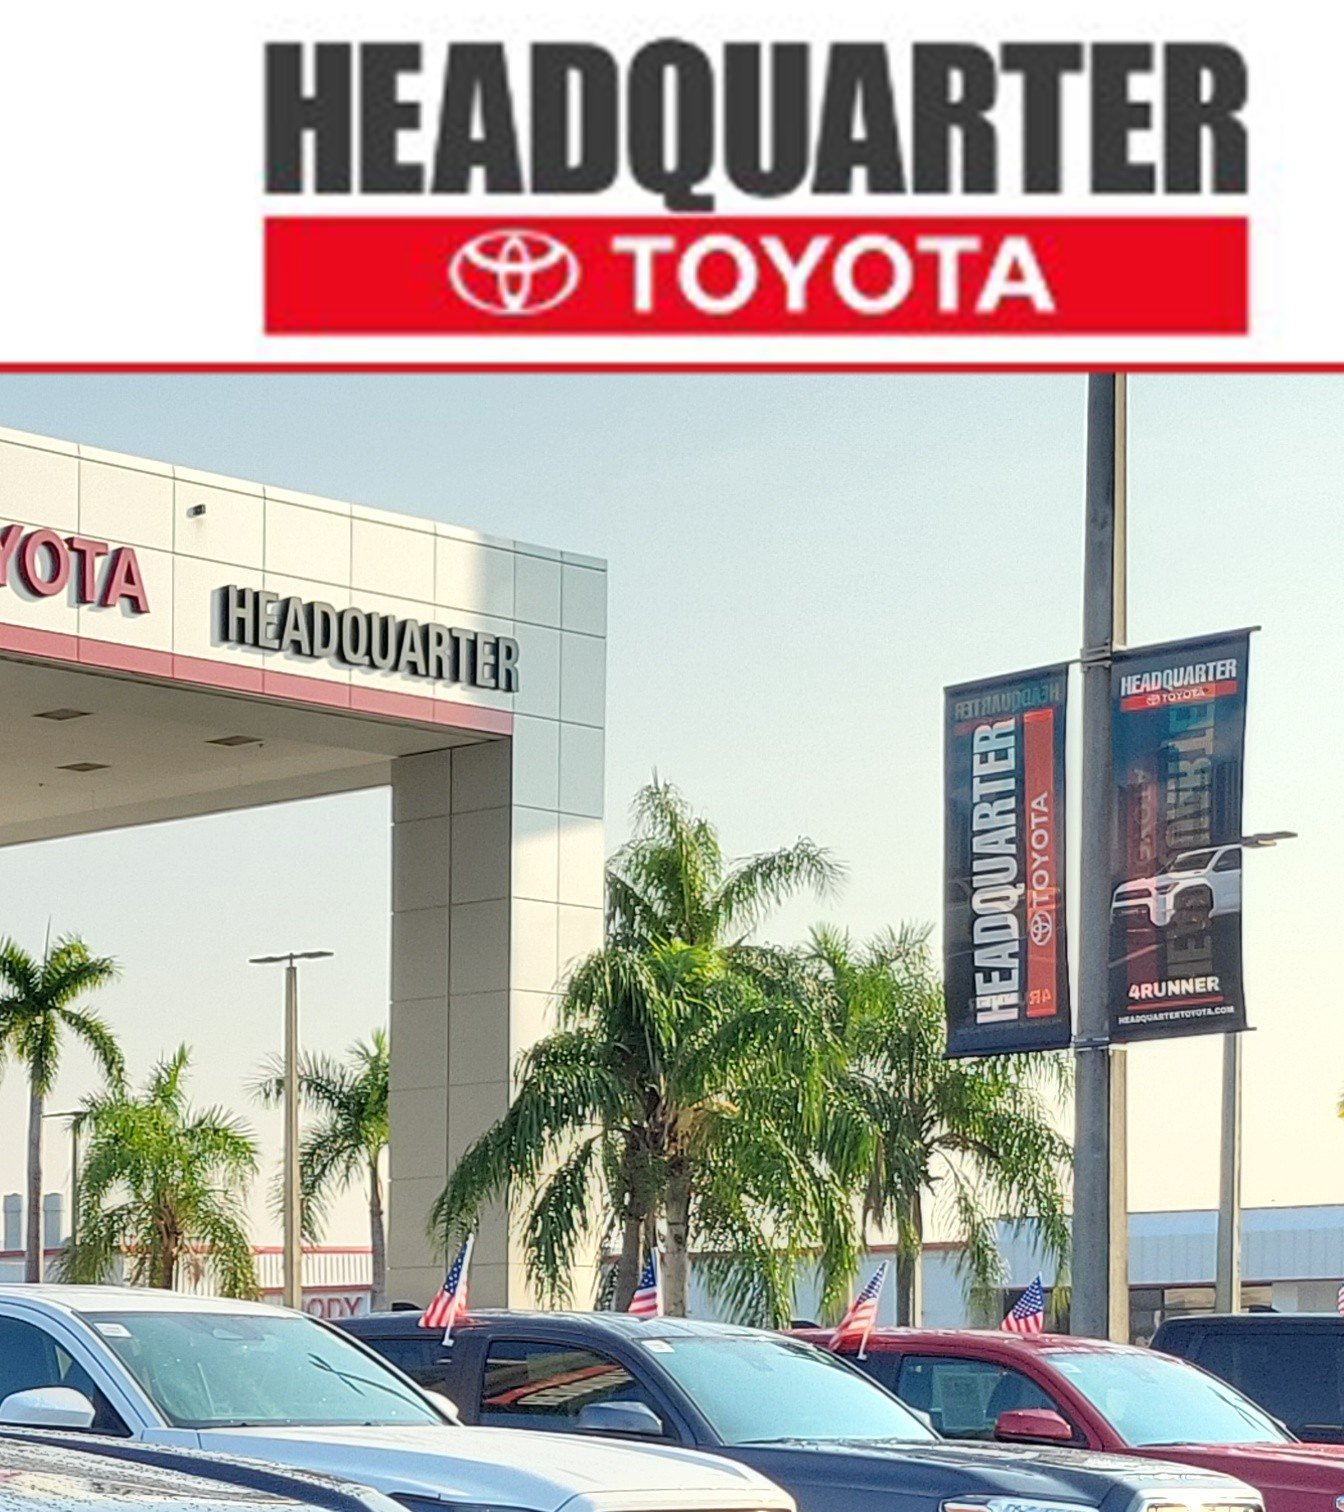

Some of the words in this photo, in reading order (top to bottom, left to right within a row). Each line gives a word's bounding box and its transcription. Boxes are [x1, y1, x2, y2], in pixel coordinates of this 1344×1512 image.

[215, 584, 520, 693] HEADQUARTER
[1121, 658, 1237, 696] HEADQUARTER
[1162, 687, 1206, 702] TOYOTA
[1031, 791, 1049, 909] TOYOTA
[972, 717, 1025, 1024] HEADQUARTER
[1128, 976, 1220, 1000] 4RUNNER
[302, 1297, 363, 1319] ODY
